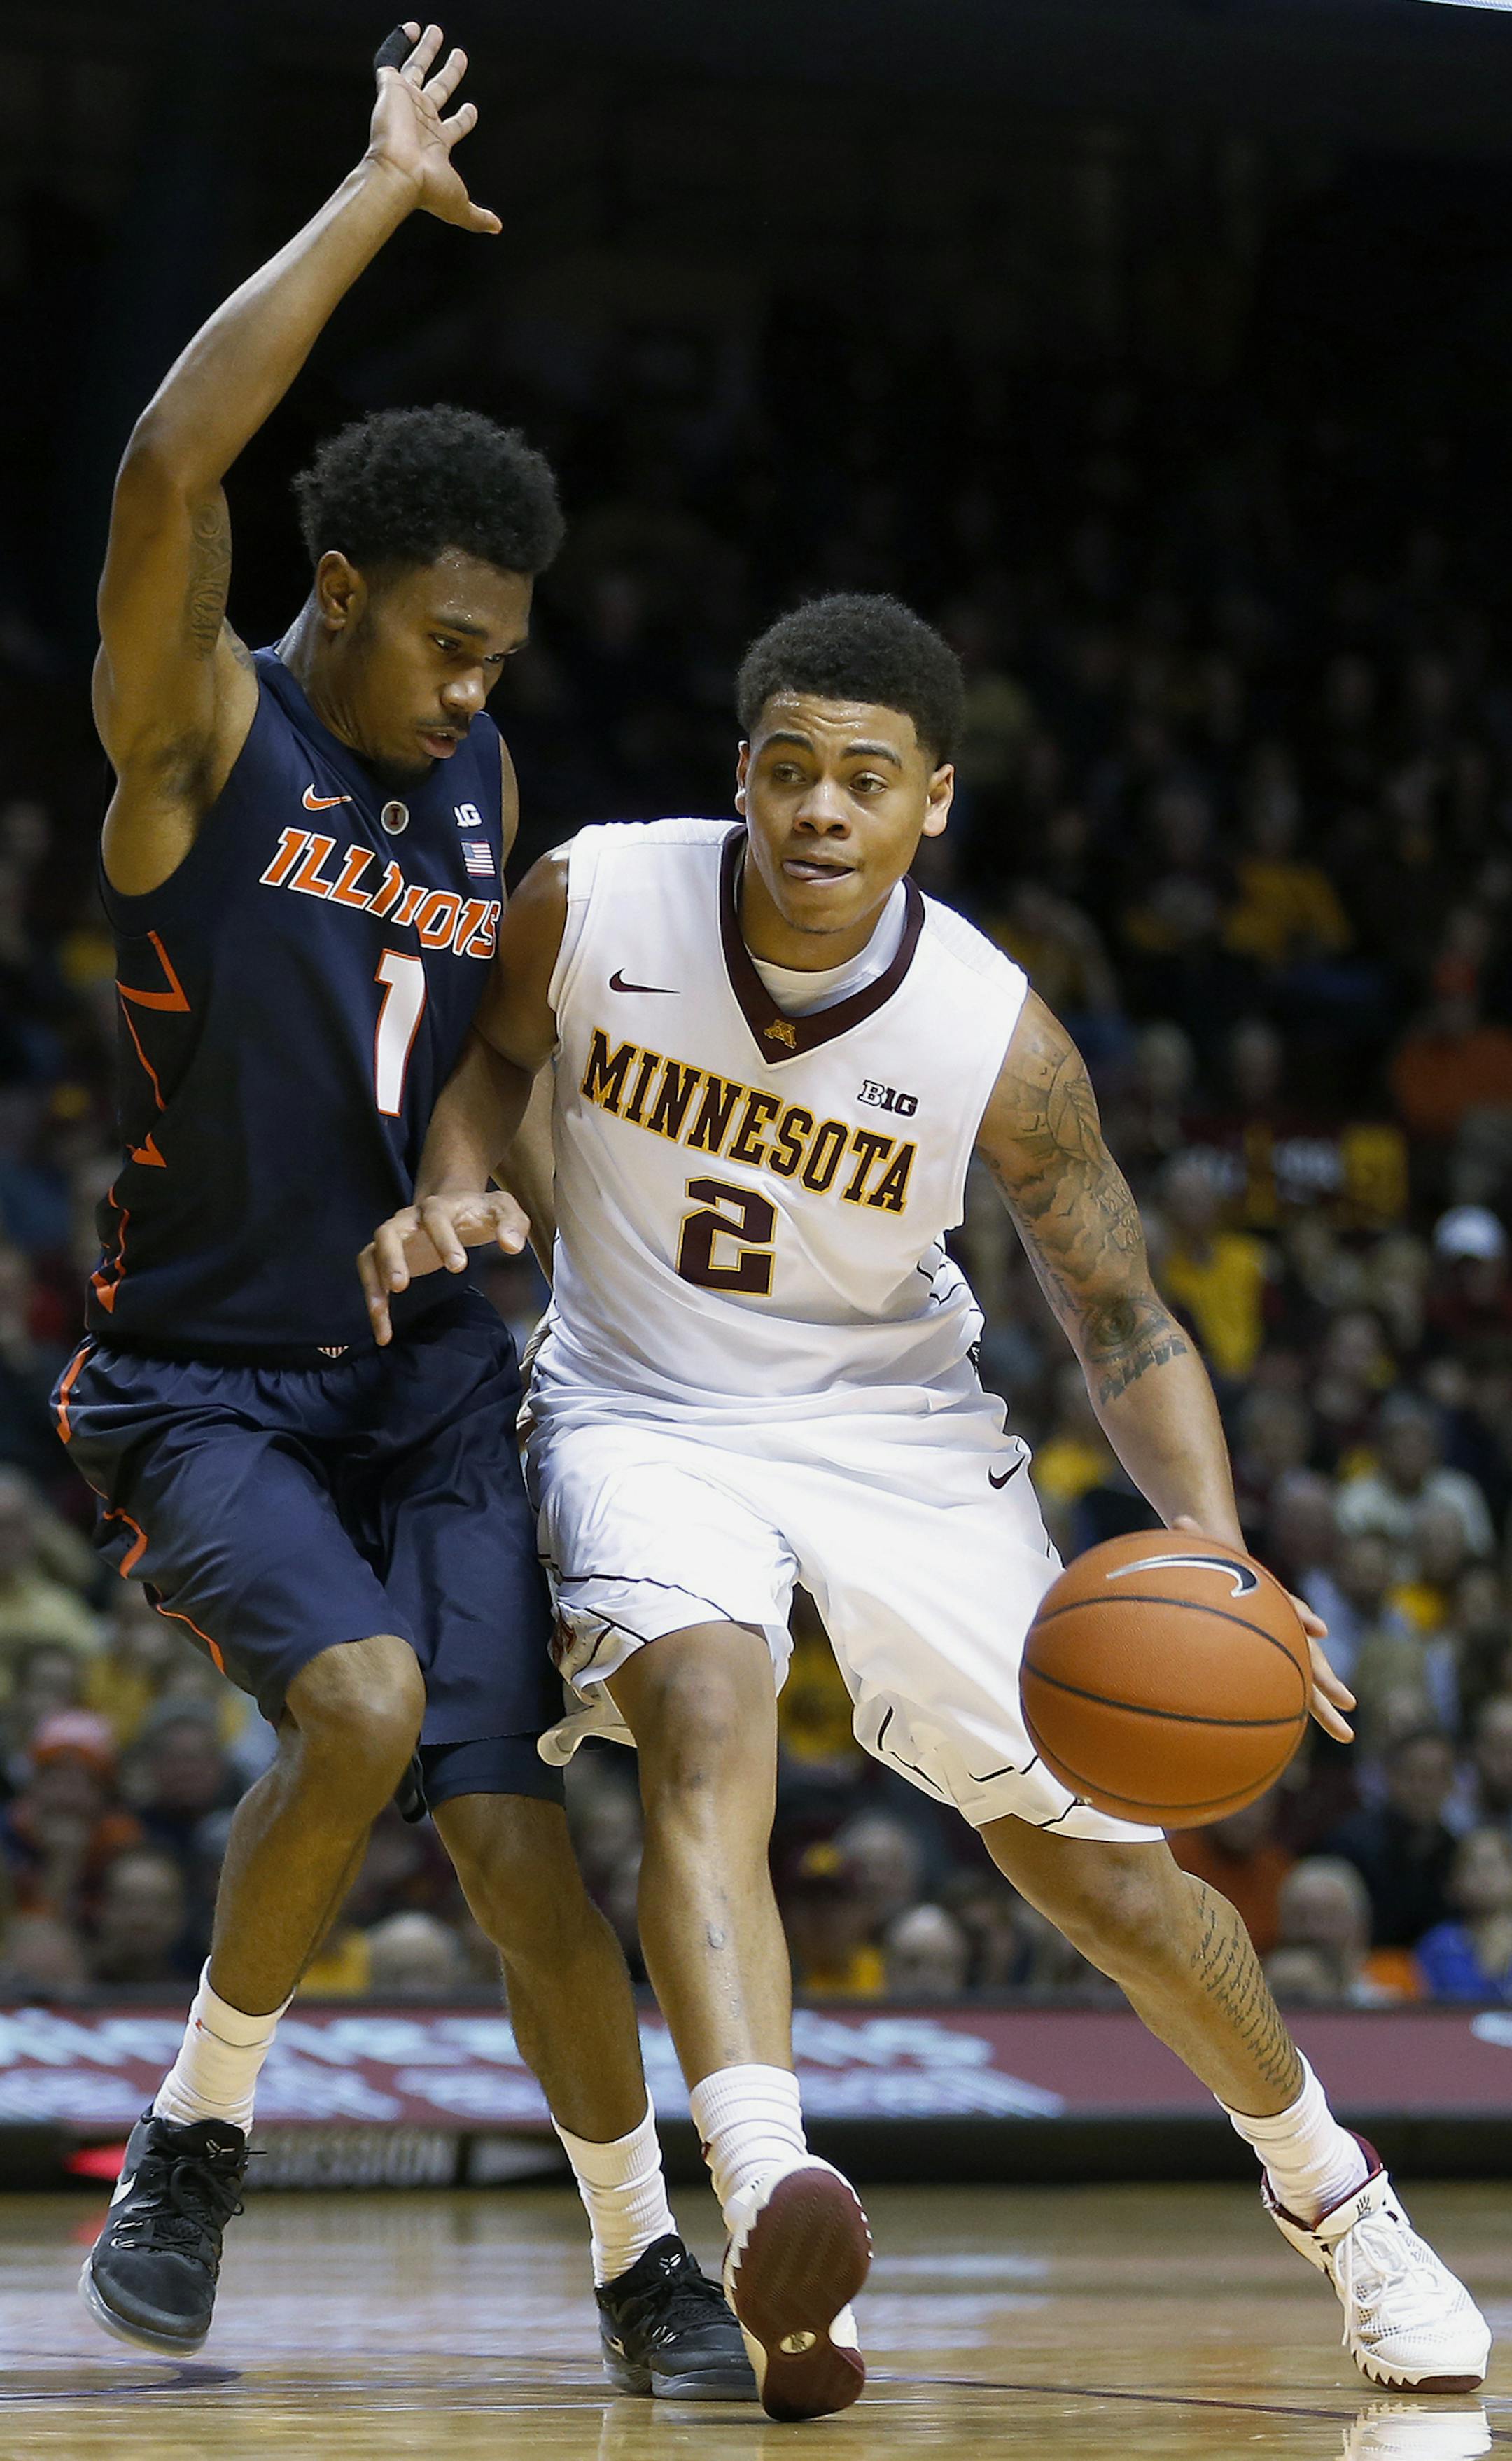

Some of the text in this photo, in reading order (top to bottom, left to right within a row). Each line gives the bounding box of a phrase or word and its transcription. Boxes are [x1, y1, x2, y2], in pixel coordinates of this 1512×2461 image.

[374, 947, 426, 1117] 1
[579, 1025, 918, 1216] MINNESOTA
[676, 1174, 778, 1297] 2
